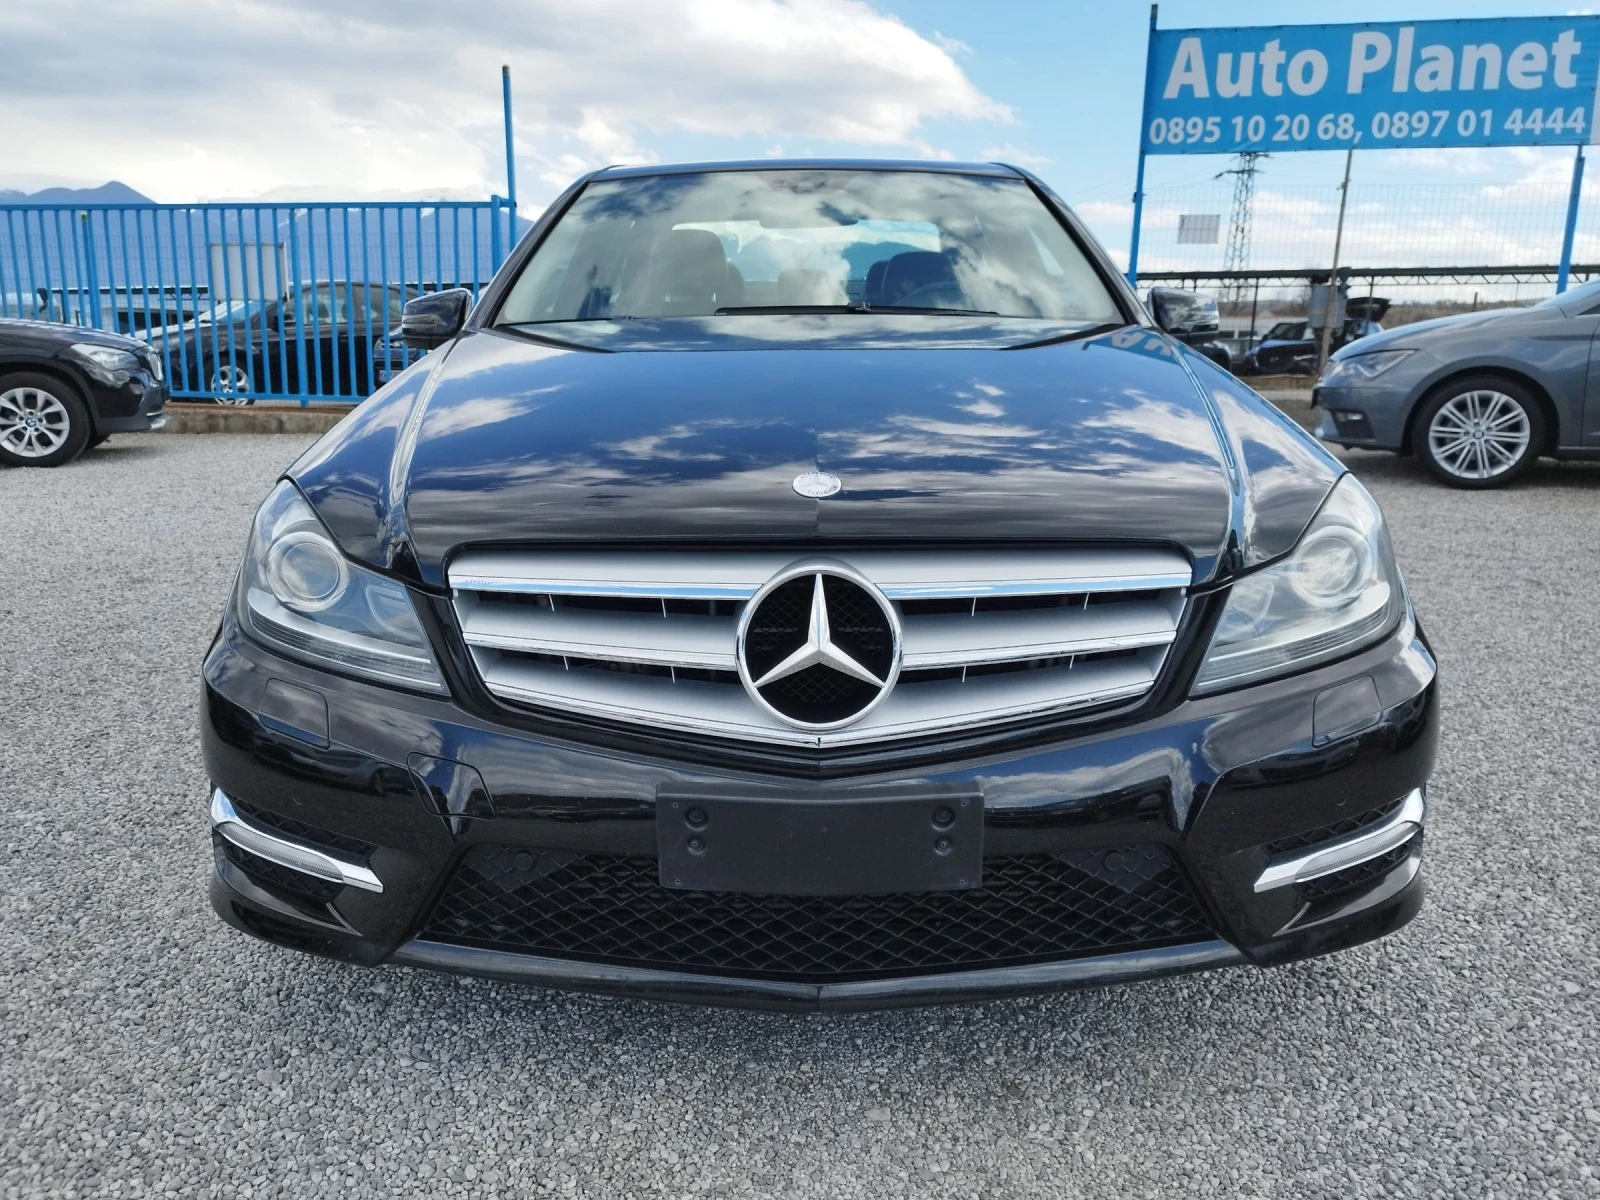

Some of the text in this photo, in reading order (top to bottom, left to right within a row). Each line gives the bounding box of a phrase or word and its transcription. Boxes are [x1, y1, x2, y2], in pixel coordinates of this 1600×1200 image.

[1162, 27, 1582, 99] Auto Planet
[1148, 107, 1587, 145] 0895 10 20 68, 0897 01 4444
